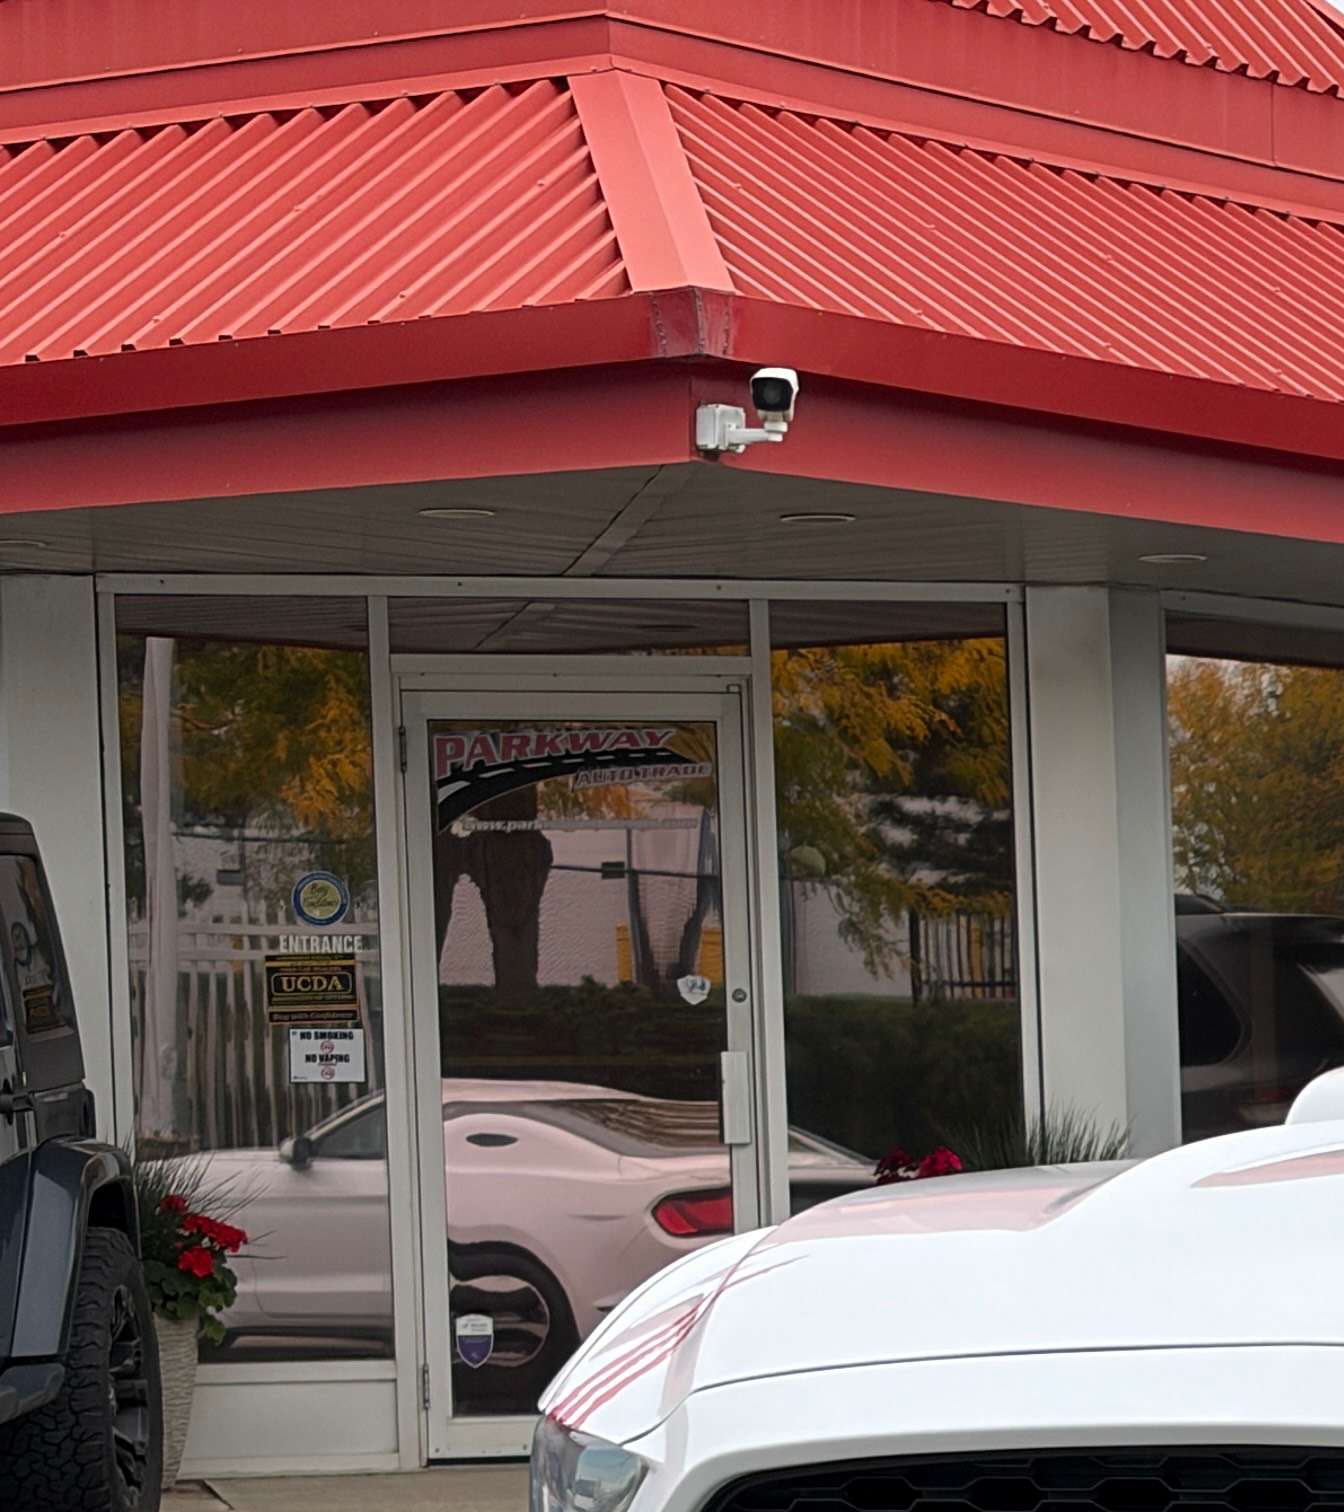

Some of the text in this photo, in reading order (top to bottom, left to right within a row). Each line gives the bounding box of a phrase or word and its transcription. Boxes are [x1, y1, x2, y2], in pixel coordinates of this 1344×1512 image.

[434, 728, 675, 779] PARKWAY
[574, 768, 636, 788] AUTO
[279, 934, 364, 953] ENTRANCE
[280, 975, 344, 992] UCDA
[300, 1031, 354, 1040] NO SMOKING
[305, 1054, 350, 1063] NO VAPING
